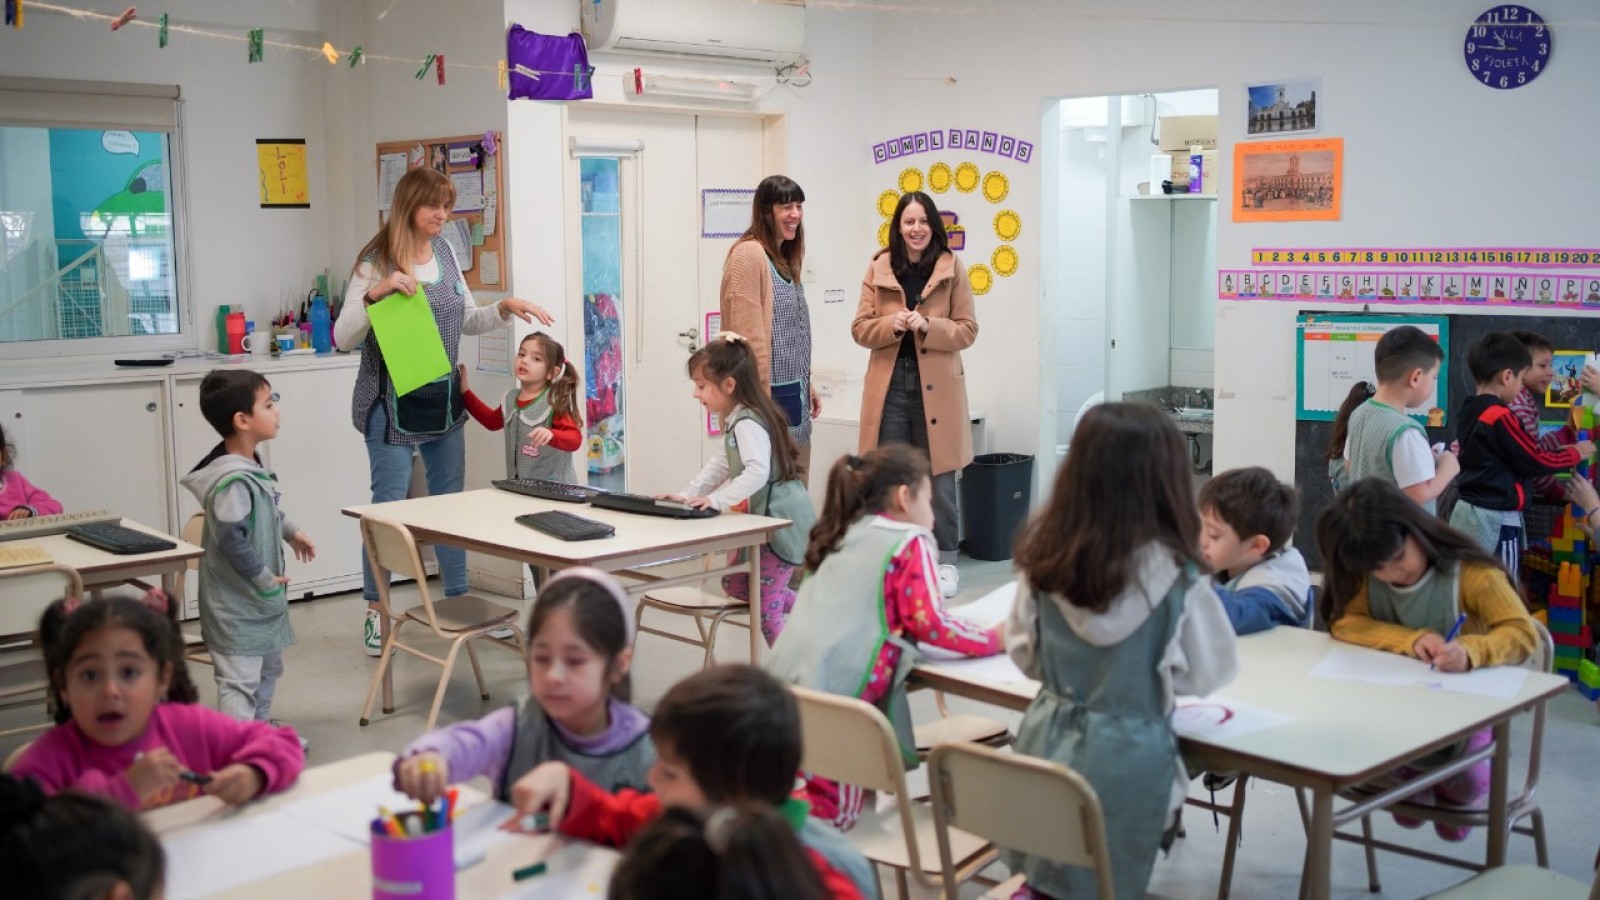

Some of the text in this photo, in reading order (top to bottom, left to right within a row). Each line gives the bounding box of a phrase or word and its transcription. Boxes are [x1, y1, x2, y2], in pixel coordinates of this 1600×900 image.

[1487, 13, 1499, 24] 11
[1503, 8, 1518, 19] 12
[1526, 14, 1531, 24] 1
[1473, 26, 1486, 37] 10
[1535, 27, 1543, 36] 2
[1468, 43, 1475, 53] 9
[1539, 44, 1546, 55] 3
[1472, 59, 1480, 70] 8
[1485, 55, 1529, 68] VIOLETA
[1532, 60, 1539, 71] 4
[1483, 72, 1490, 83] 7
[1500, 76, 1508, 87] 6
[1518, 72, 1525, 83] 5
[877, 134, 1026, 159] CUMPLEAÑOS
[1259, 252, 1262, 262] 1
[1272, 252, 1279, 262] 2
[1288, 252, 1294, 262] 3
[1302, 252, 1310, 262] 4
[1319, 252, 1325, 262] 5
[1332, 252, 1340, 262] 6
[1350, 252, 1357, 262] 7
[1366, 252, 1373, 262] 8
[1381, 252, 1388, 262] 9
[1395, 252, 1408, 262] 10
[1412, 252, 1423, 262] 11
[1429, 253, 1442, 263] 12
[1446, 253, 1459, 263] 13
[1464, 253, 1477, 263] 14
[1482, 253, 1495, 263] 15
[1500, 253, 1513, 263] 16
[1517, 253, 1531, 263] 17
[1535, 253, 1550, 263] 18
[1554, 253, 1569, 263] 19
[1573, 253, 1588, 263] 20
[1225, 275, 1600, 292] A B C D E F G H I J K L M N Ñ O P Q
